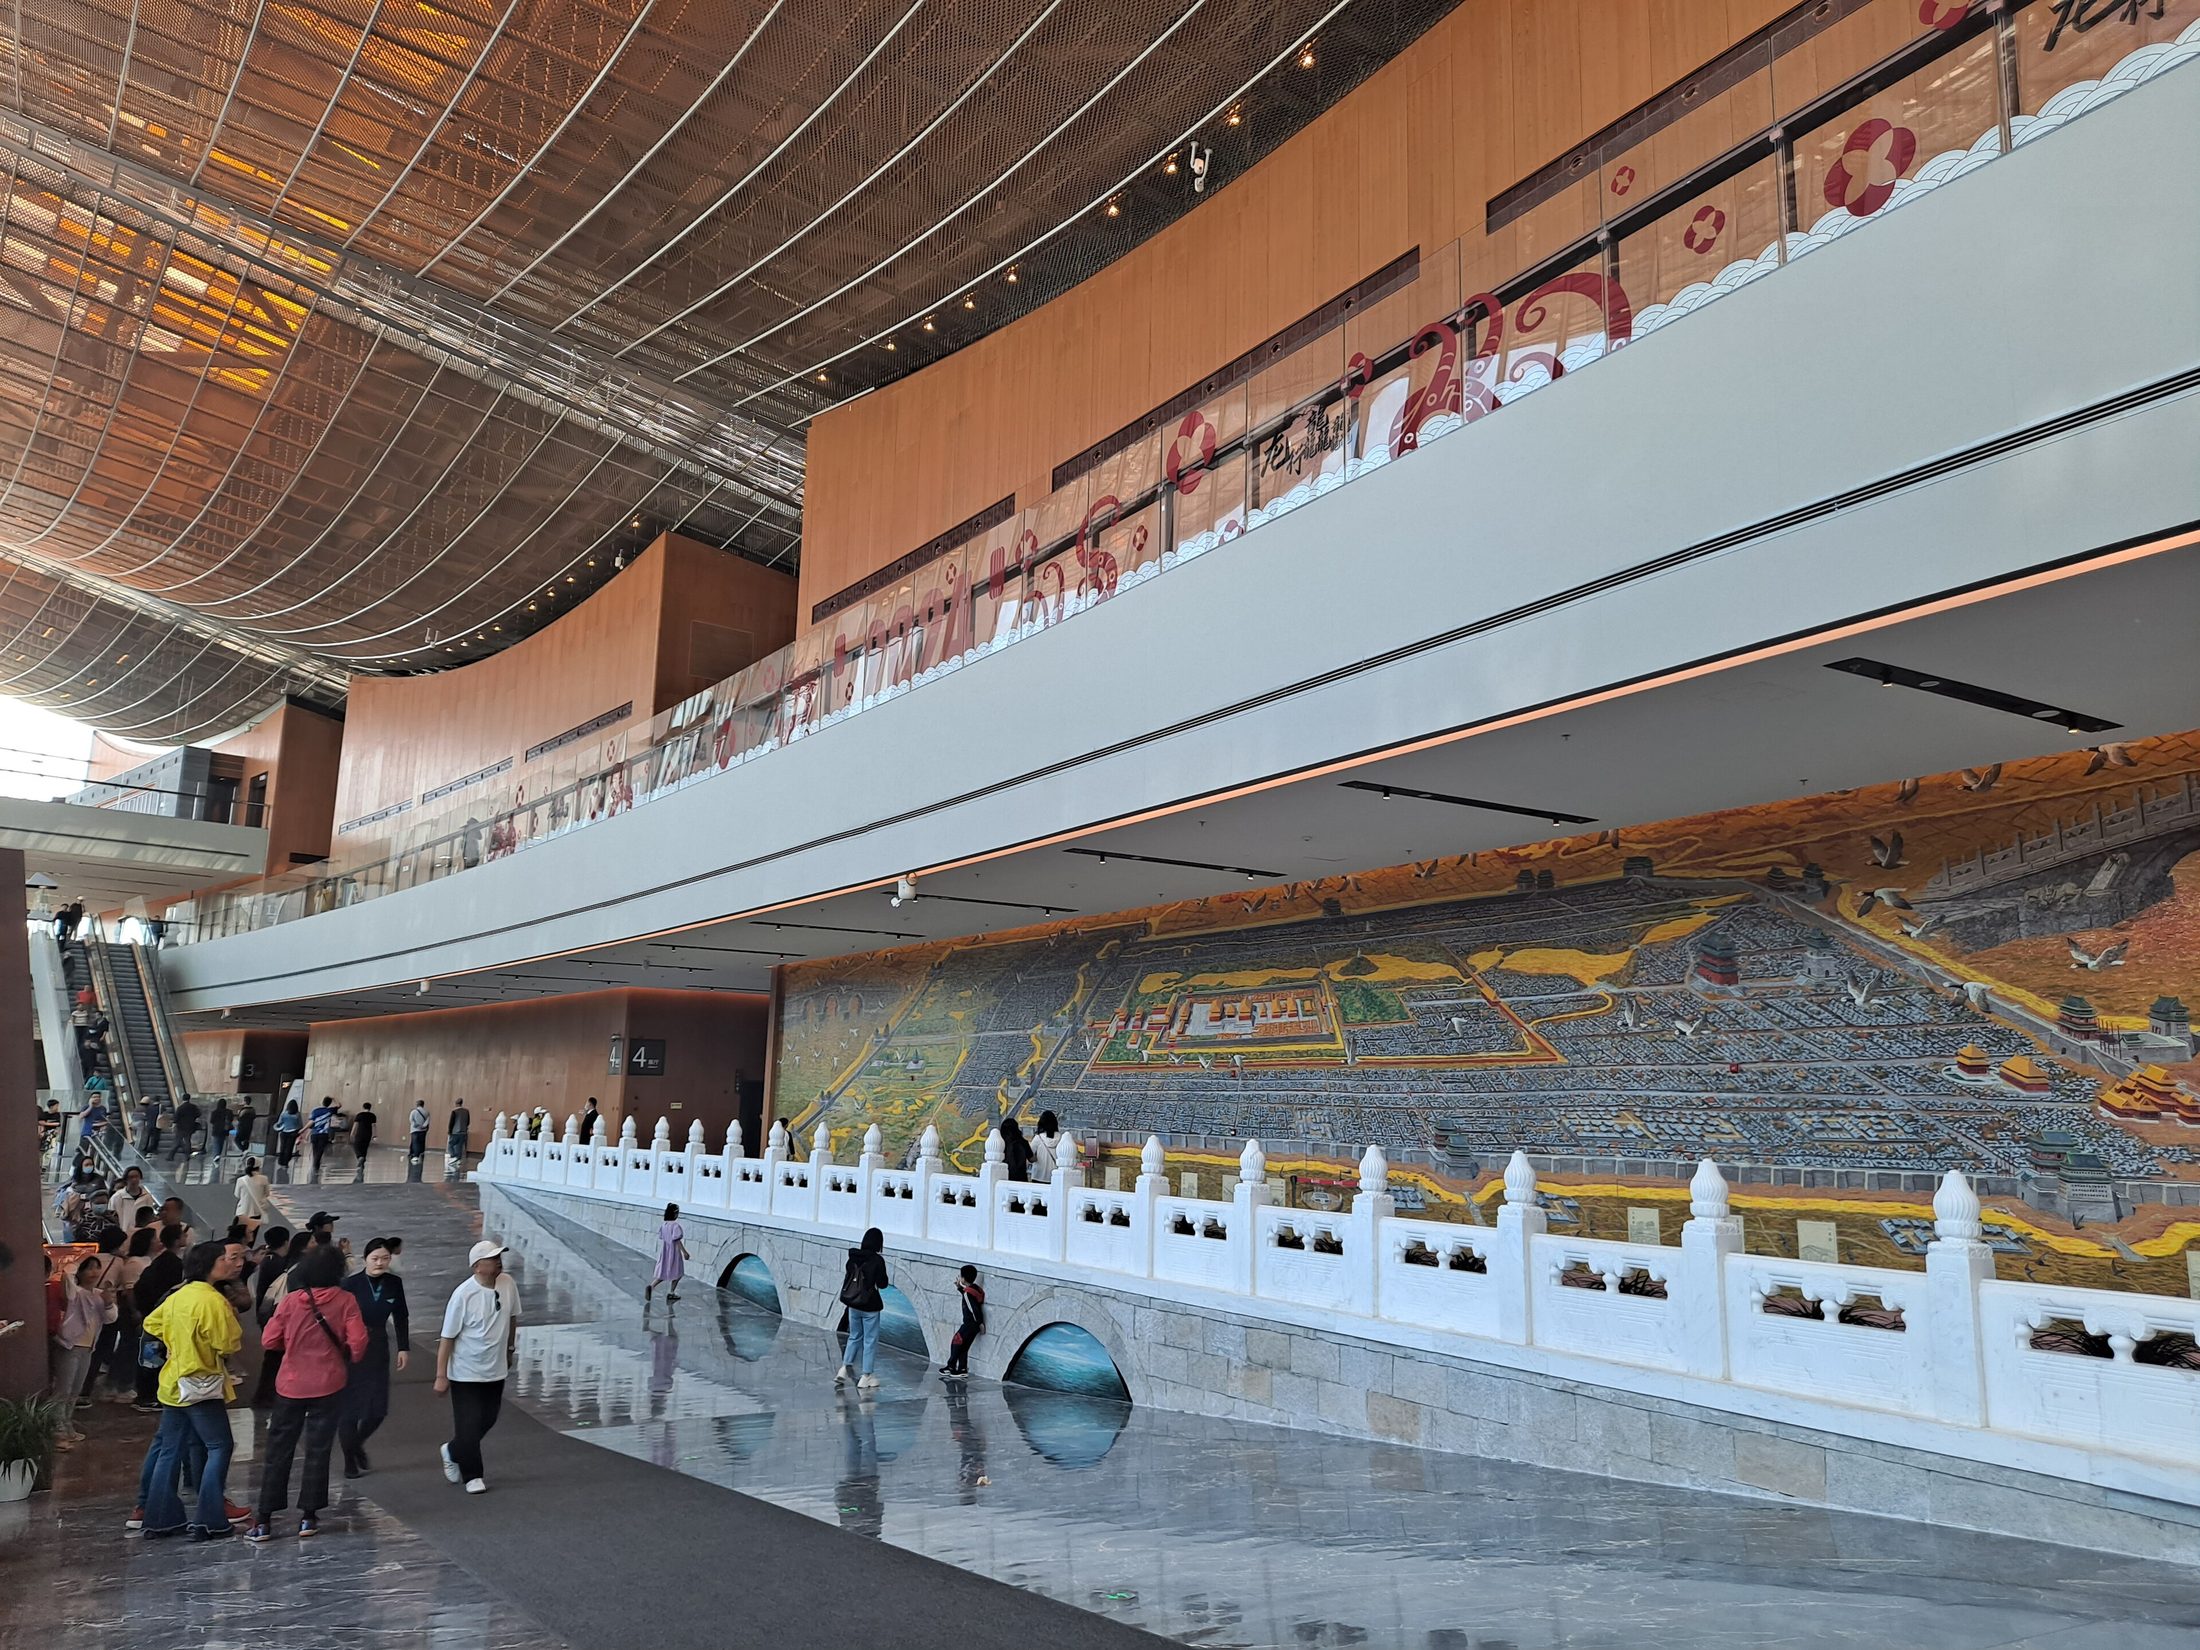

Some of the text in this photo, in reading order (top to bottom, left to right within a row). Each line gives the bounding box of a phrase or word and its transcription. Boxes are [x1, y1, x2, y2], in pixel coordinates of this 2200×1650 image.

[609, 1046, 616, 1068] 4
[632, 1046, 647, 1068] 4
[244, 1063, 254, 1077] 3
